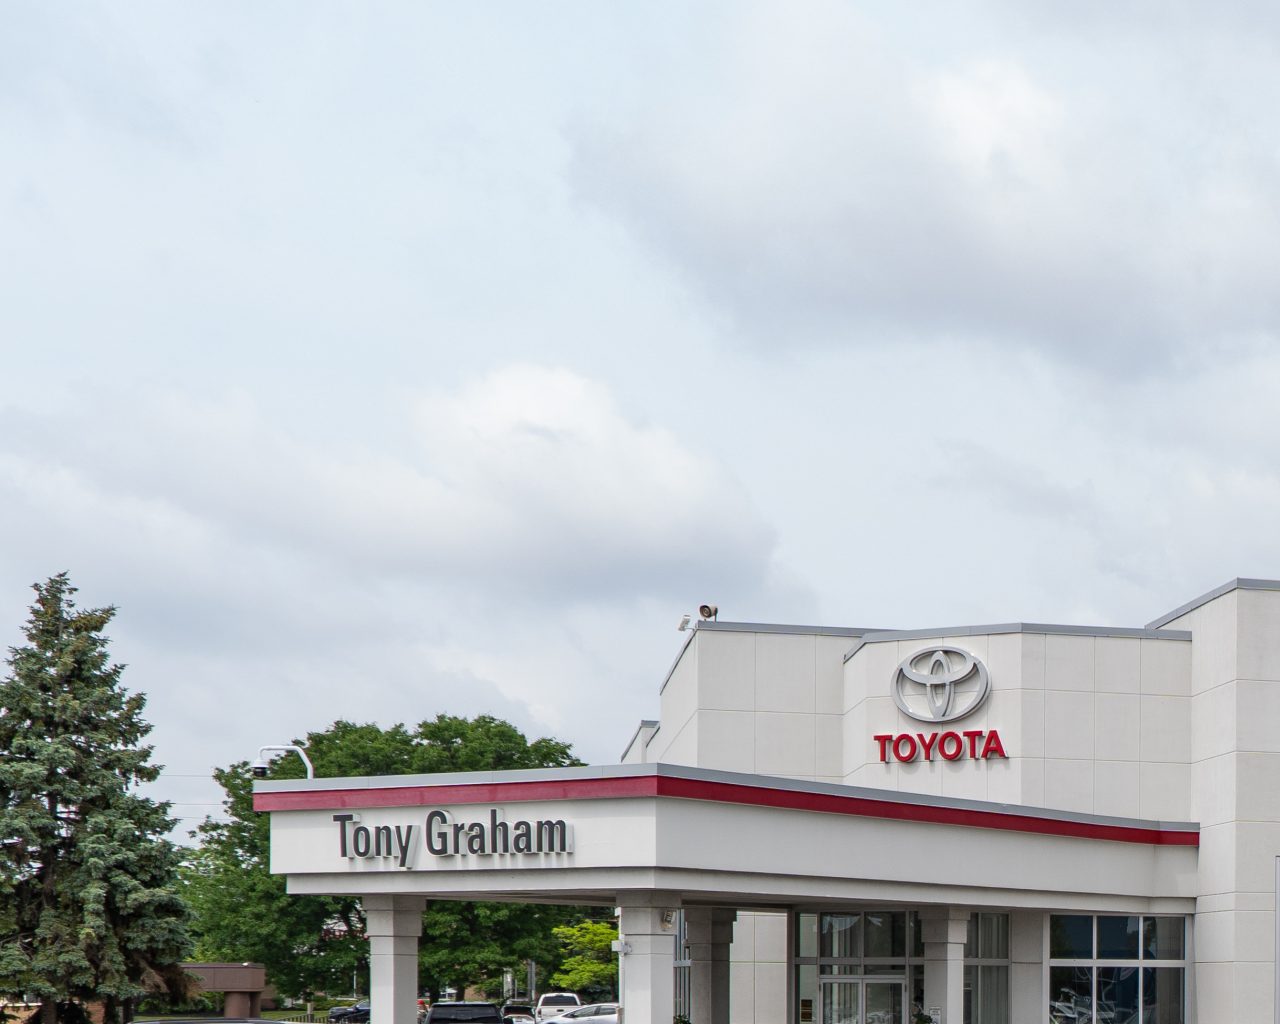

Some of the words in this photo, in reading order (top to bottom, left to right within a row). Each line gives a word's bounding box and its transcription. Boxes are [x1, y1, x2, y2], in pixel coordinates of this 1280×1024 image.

[873, 729, 1006, 763] TOYOTA
[332, 813, 415, 868] Tony
[425, 807, 570, 857] Graham
